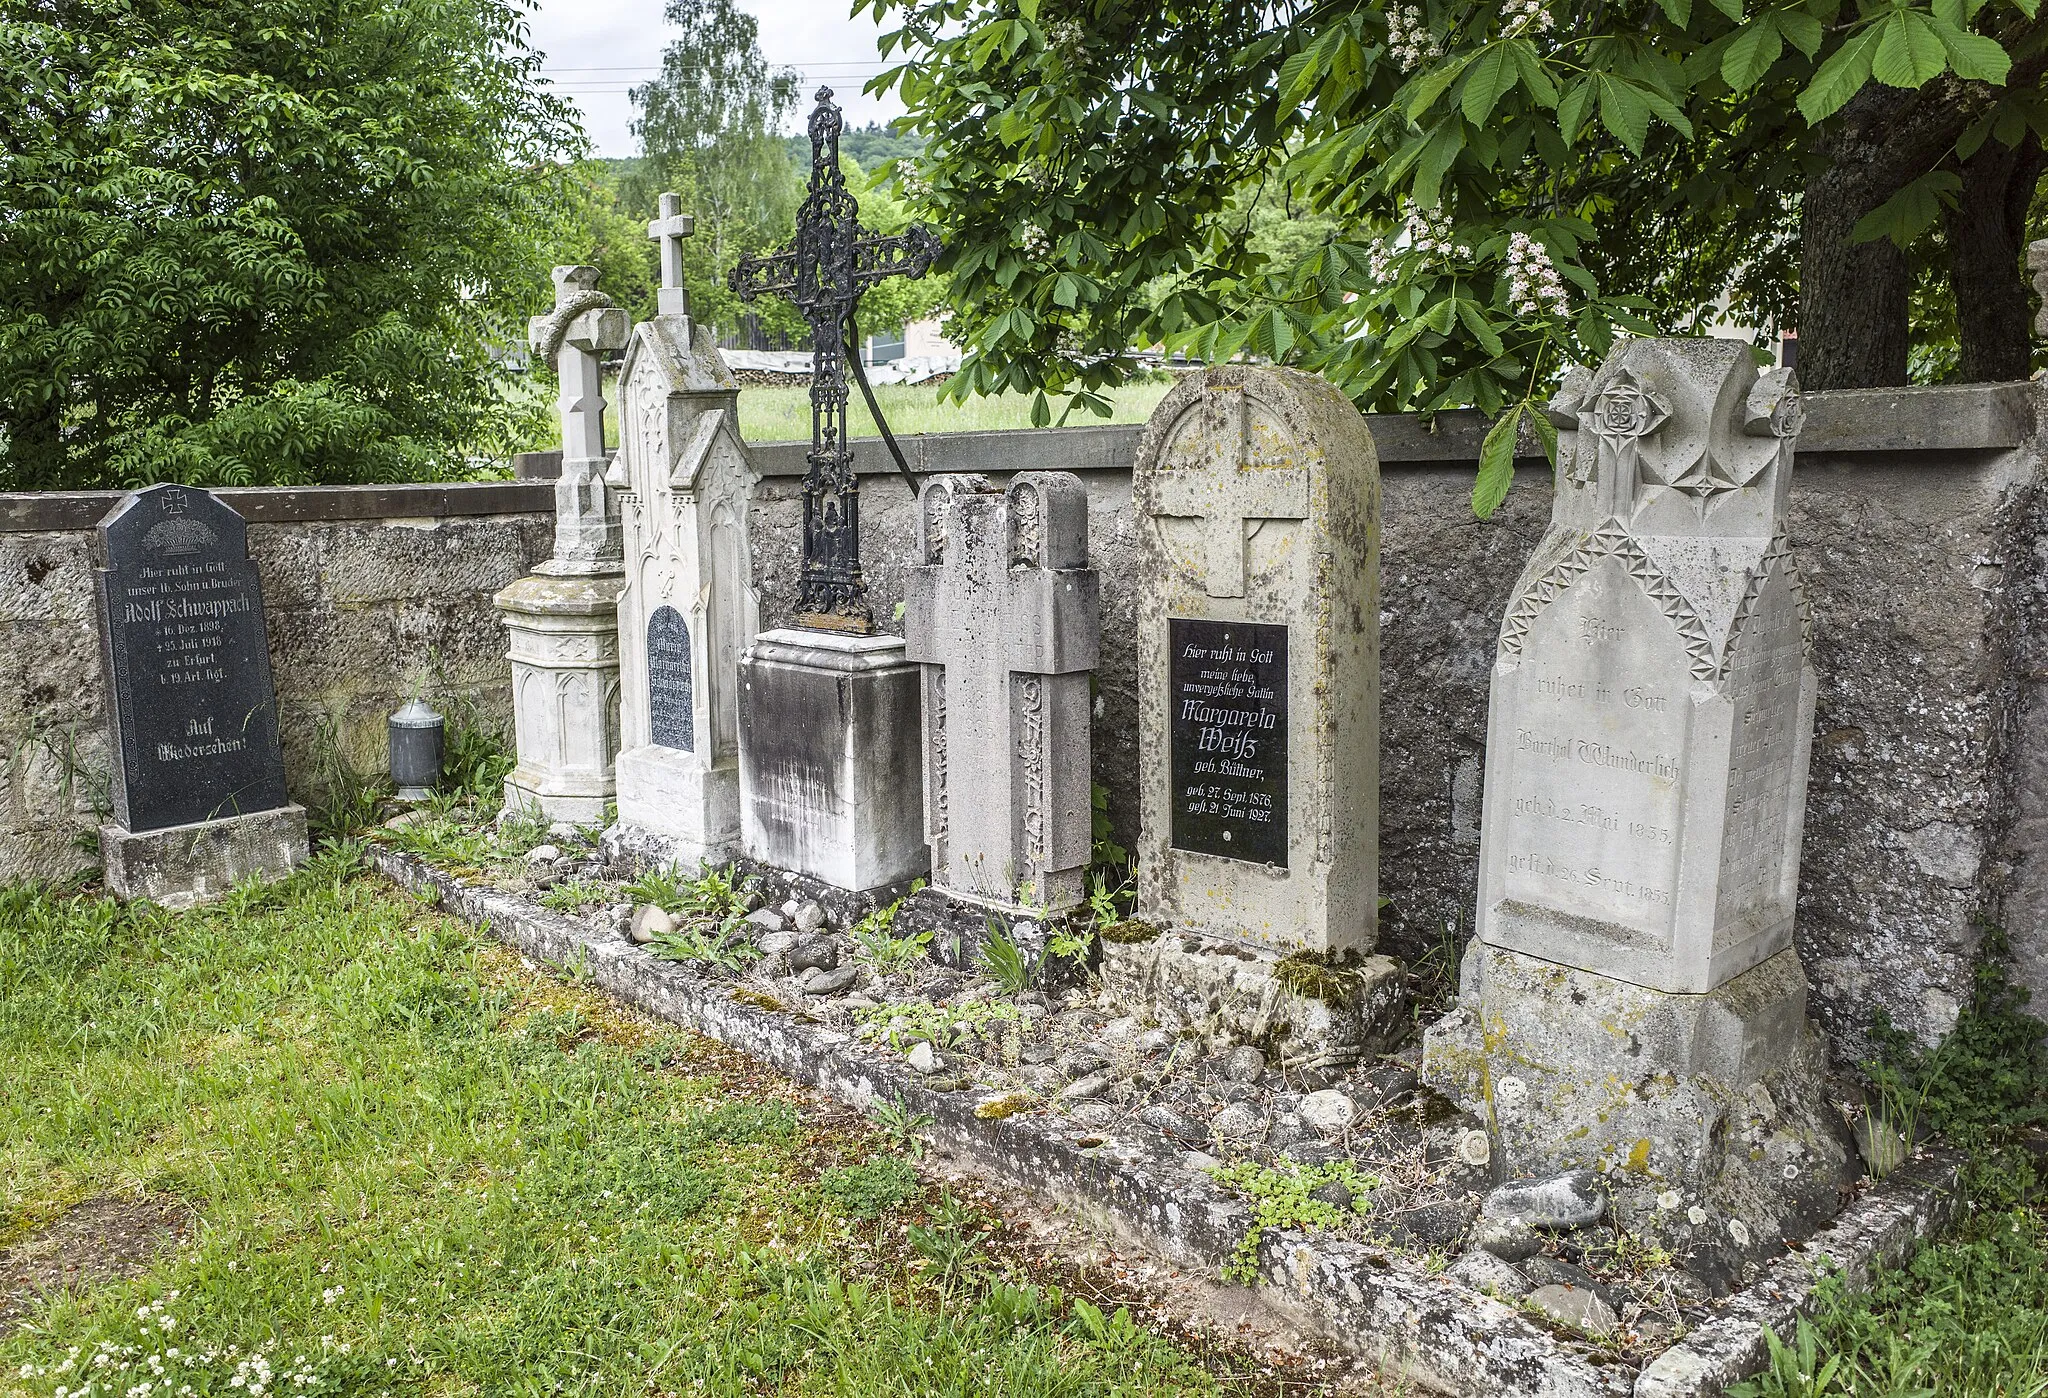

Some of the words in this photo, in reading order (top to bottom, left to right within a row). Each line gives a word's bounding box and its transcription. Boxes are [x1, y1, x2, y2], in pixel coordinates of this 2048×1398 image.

[139, 566, 162, 578] Hier
[167, 564, 188, 577] ruht
[192, 565, 203, 574] in
[205, 561, 225, 573] Gott
[127, 586, 157, 596] unser
[175, 580, 200, 592] Sohn
[211, 578, 242, 589] Bruder
[124, 600, 164, 623] Adolf
[165, 592, 249, 619] Schwappach
[179, 638, 198, 650] Juli
[202, 636, 222, 648] 1918
[1579, 616, 1626, 645] Hier
[166, 659, 180, 668] zu
[1182, 643, 1207, 658] Hier
[1210, 644, 1233, 664] ruht
[1235, 647, 1246, 662] in
[1249, 648, 1273, 664] Gott
[1200, 667, 1229, 680] meine
[1231, 667, 1255, 685] liebe,
[1246, 685, 1274, 700] Gattin
[1537, 675, 1585, 702] ruhet
[1596, 681, 1611, 704] in
[1623, 686, 1667, 714] Gott
[186, 716, 214, 736] Auf
[1182, 699, 1276, 729] Margareta
[157, 735, 247, 761] Wiedersehen!
[1198, 726, 1259, 760] Weiß
[1193, 757, 1216, 774] geb.
[1218, 759, 1265, 783] Büttner,
[1577, 739, 1680, 786] Wunderlich
[1185, 783, 1206, 797] geb.
[1207, 786, 1221, 799] 27.
[1222, 788, 1248, 804] Sept.
[1249, 792, 1273, 810] 1876,
[1221, 803, 1246, 818] Juni
[1248, 808, 1271, 823] 1927.
[1576, 803, 1618, 831] Mai
